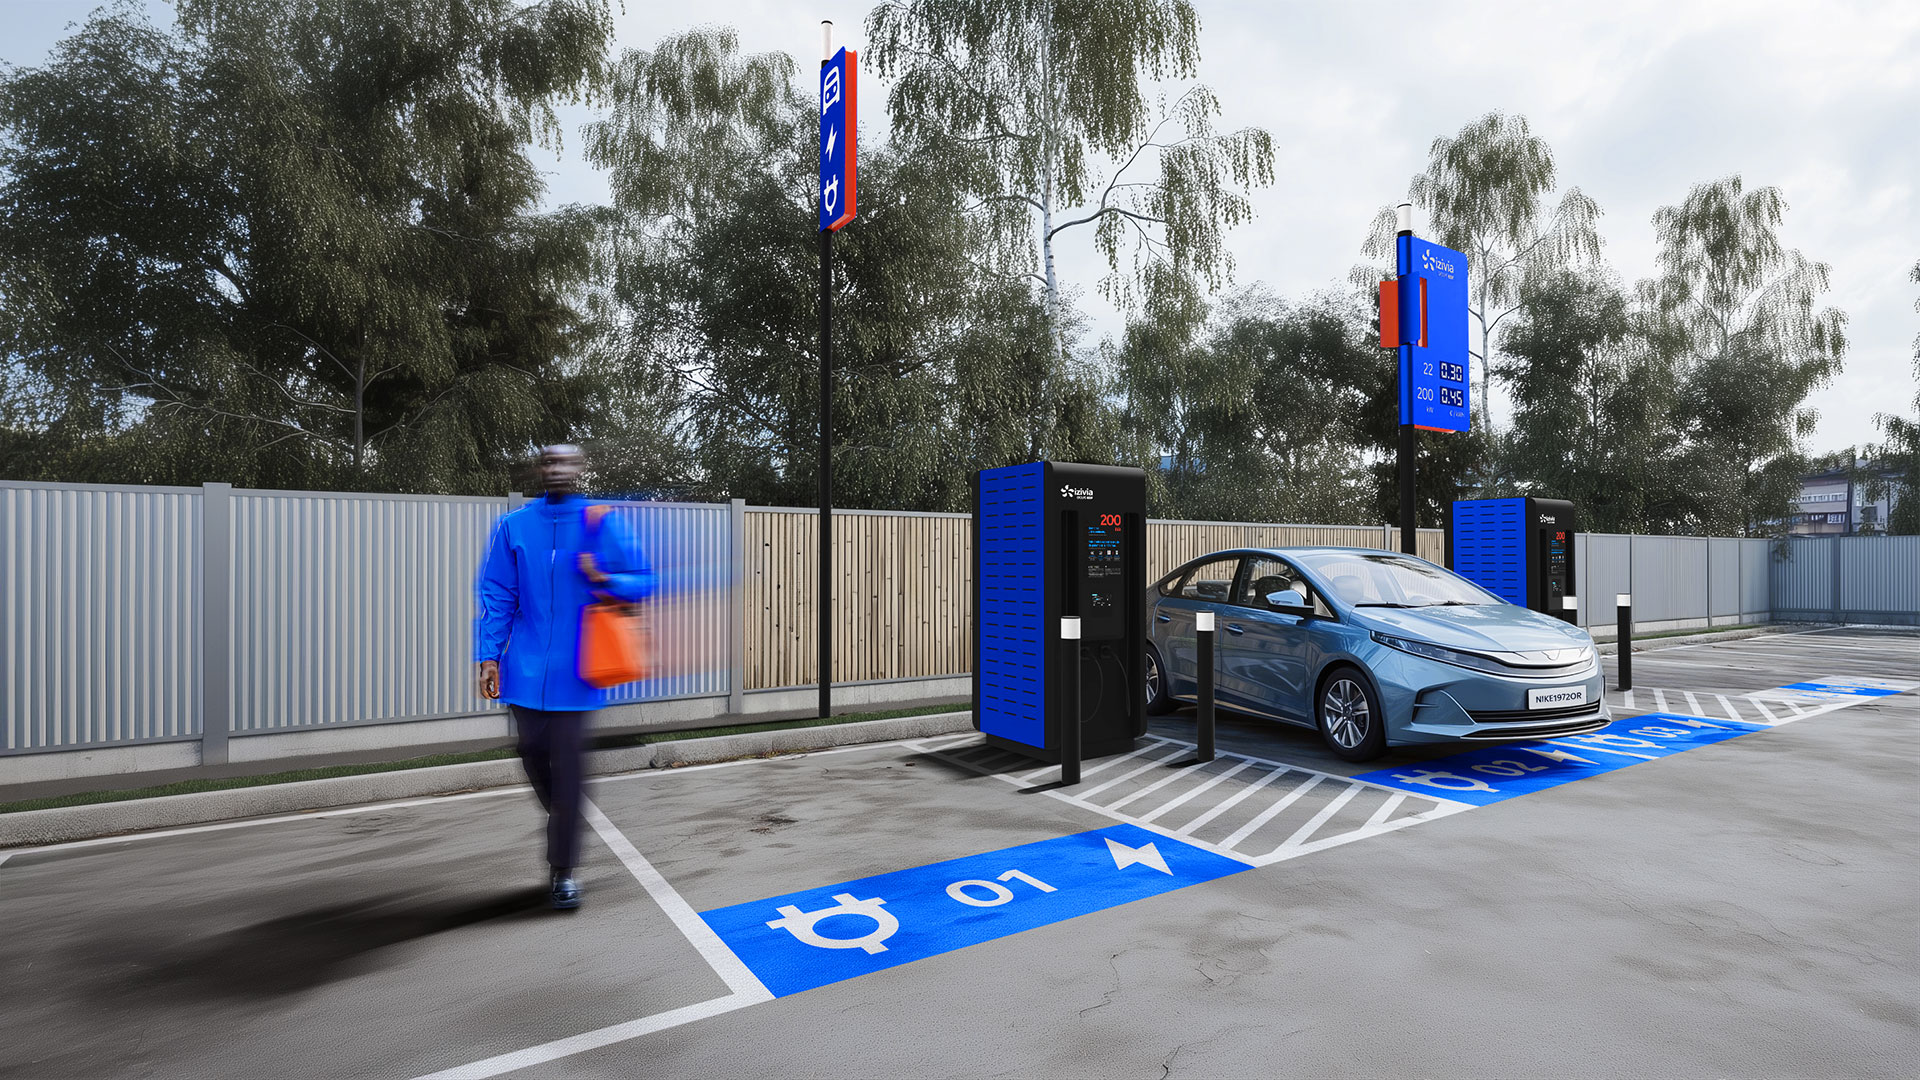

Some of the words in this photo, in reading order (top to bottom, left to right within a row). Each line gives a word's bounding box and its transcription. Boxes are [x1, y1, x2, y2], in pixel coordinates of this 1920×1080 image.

[1435, 256, 1454, 274] izivia
[1423, 362, 1433, 376] 22
[1441, 362, 1462, 382] 0.30
[1417, 386, 1434, 402] 200
[1441, 387, 1463, 407] 0.45
[1074, 487, 1094, 496] izivia
[1100, 514, 1121, 526] 200
[1556, 531, 1565, 540] 200
[1628, 726, 1691, 738] 03
[1471, 760, 1549, 777] 02
[945, 869, 1058, 907] 01
